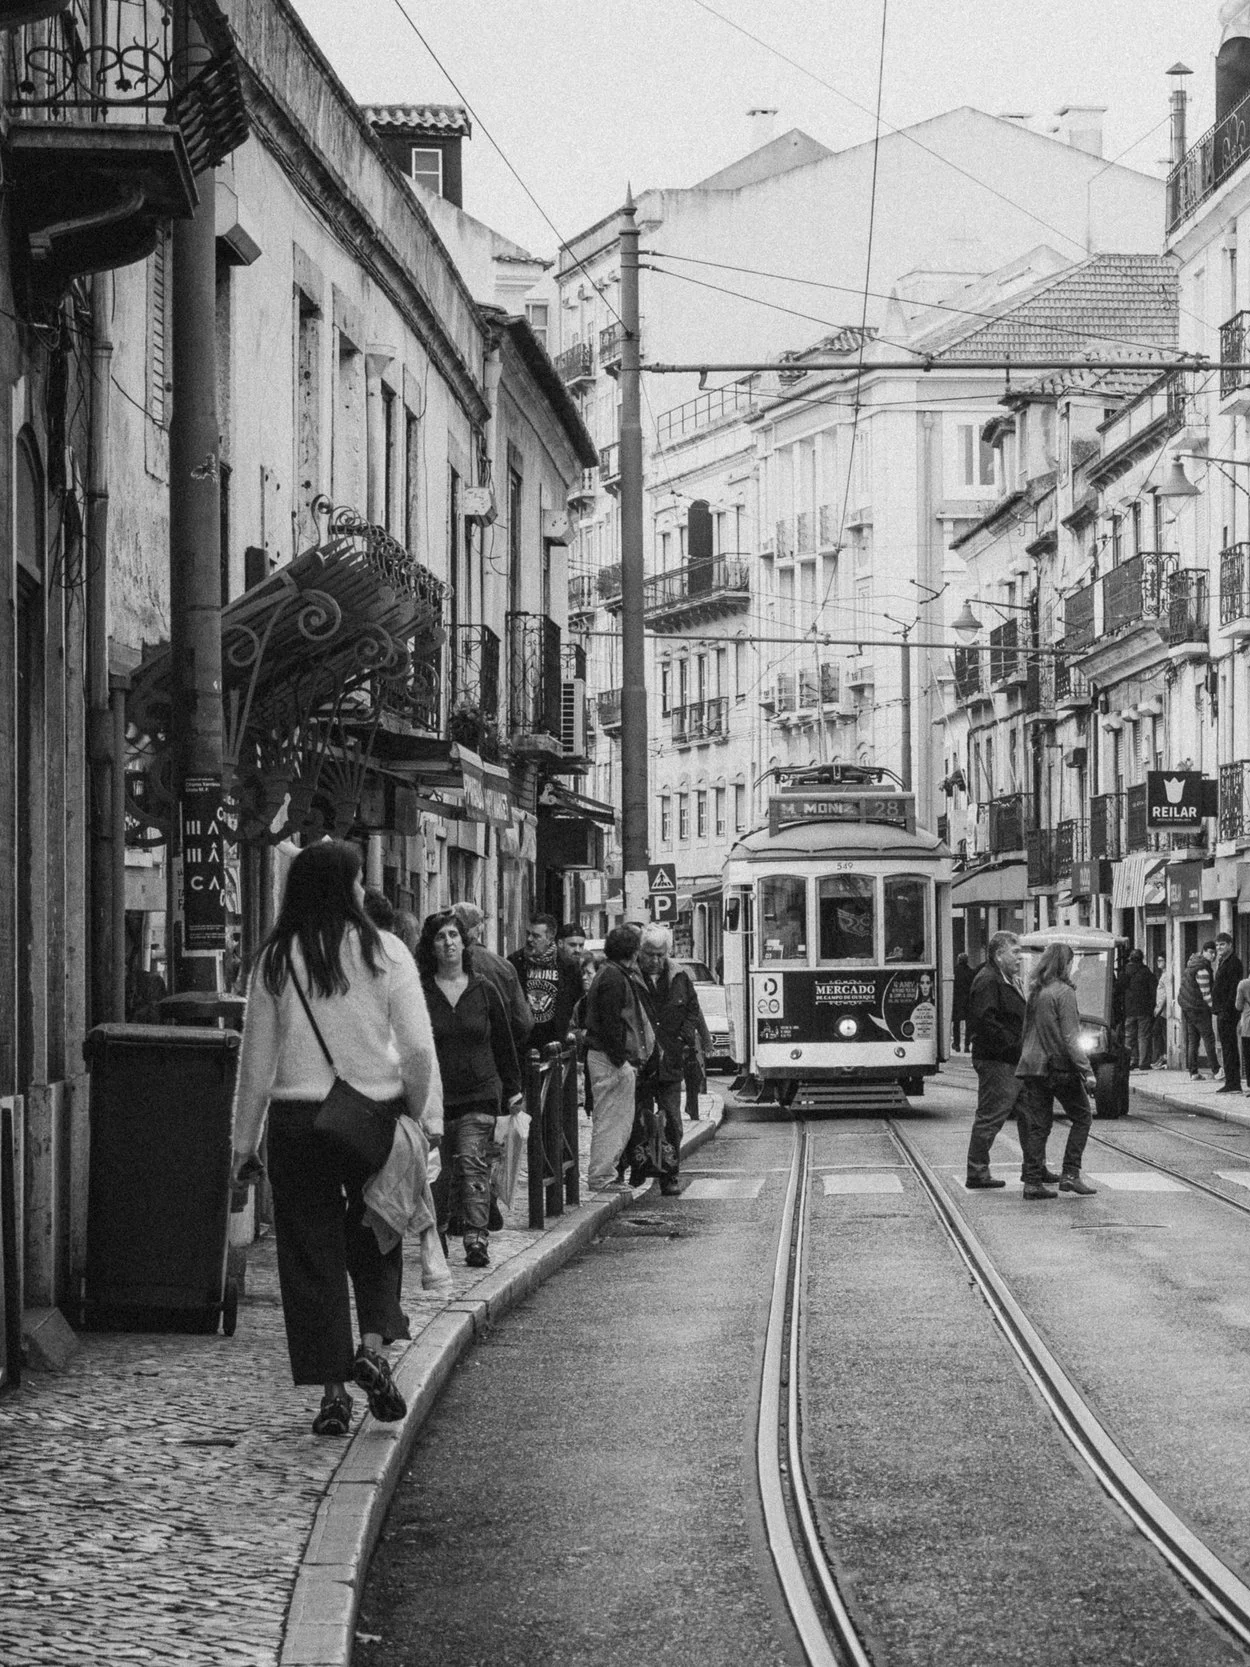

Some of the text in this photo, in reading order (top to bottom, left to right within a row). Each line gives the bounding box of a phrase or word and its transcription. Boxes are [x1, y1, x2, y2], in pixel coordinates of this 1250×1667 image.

[874, 801, 899, 817] 28
[1152, 806, 1197, 818] REILAR
[836, 862, 854, 871] 549
[654, 895, 672, 921] P
[815, 985, 875, 995] MERCADO
